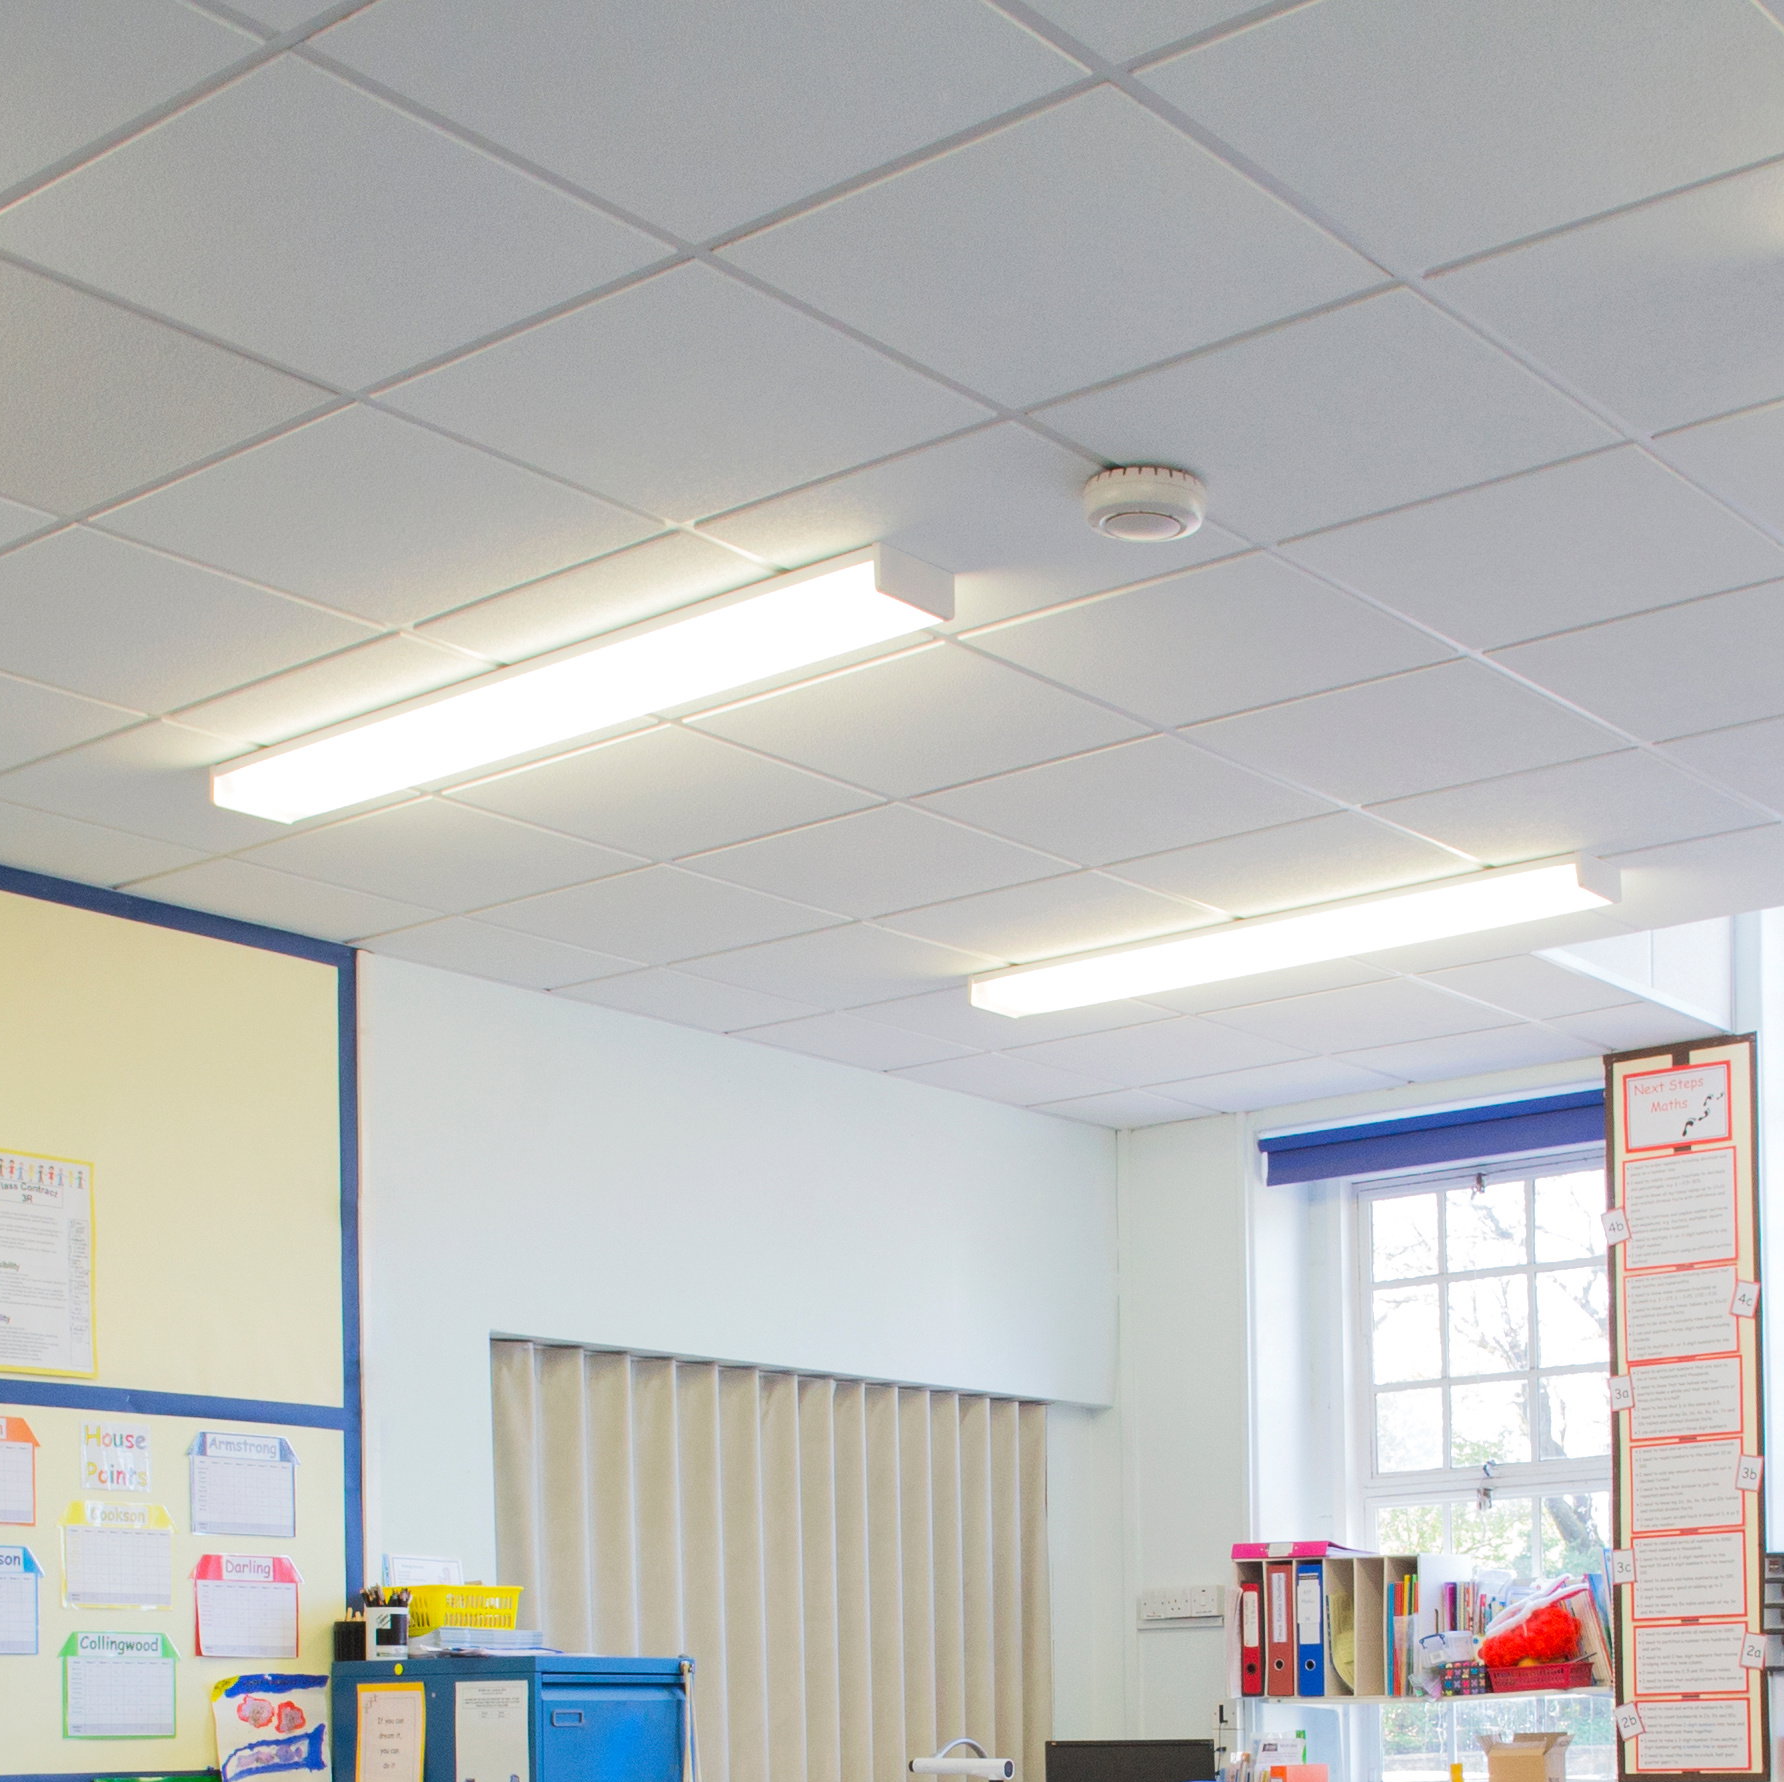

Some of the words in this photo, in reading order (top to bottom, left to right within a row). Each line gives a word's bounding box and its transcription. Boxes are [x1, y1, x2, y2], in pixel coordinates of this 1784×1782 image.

[1634, 1081, 1664, 1096] Next
[1669, 1078, 1704, 1091] Steps
[1650, 1098, 1688, 1113] Maths
[21, 1182, 58, 1198] Contract
[1608, 1222, 1624, 1233] 4b
[1738, 1293, 1753, 1306] 4c
[1615, 1388, 1629, 1400] 3a
[84, 1425, 146, 1449] House
[208, 1436, 278, 1457] Armstrong
[87, 1461, 147, 1486] Points
[1742, 1467, 1757, 1480] 3b
[225, 1560, 272, 1578] Darling
[1616, 1562, 1632, 1573] 3c
[80, 1636, 158, 1655] Collingwood
[1747, 1645, 1761, 1658] 2a
[1621, 1715, 1637, 1728] 2b
